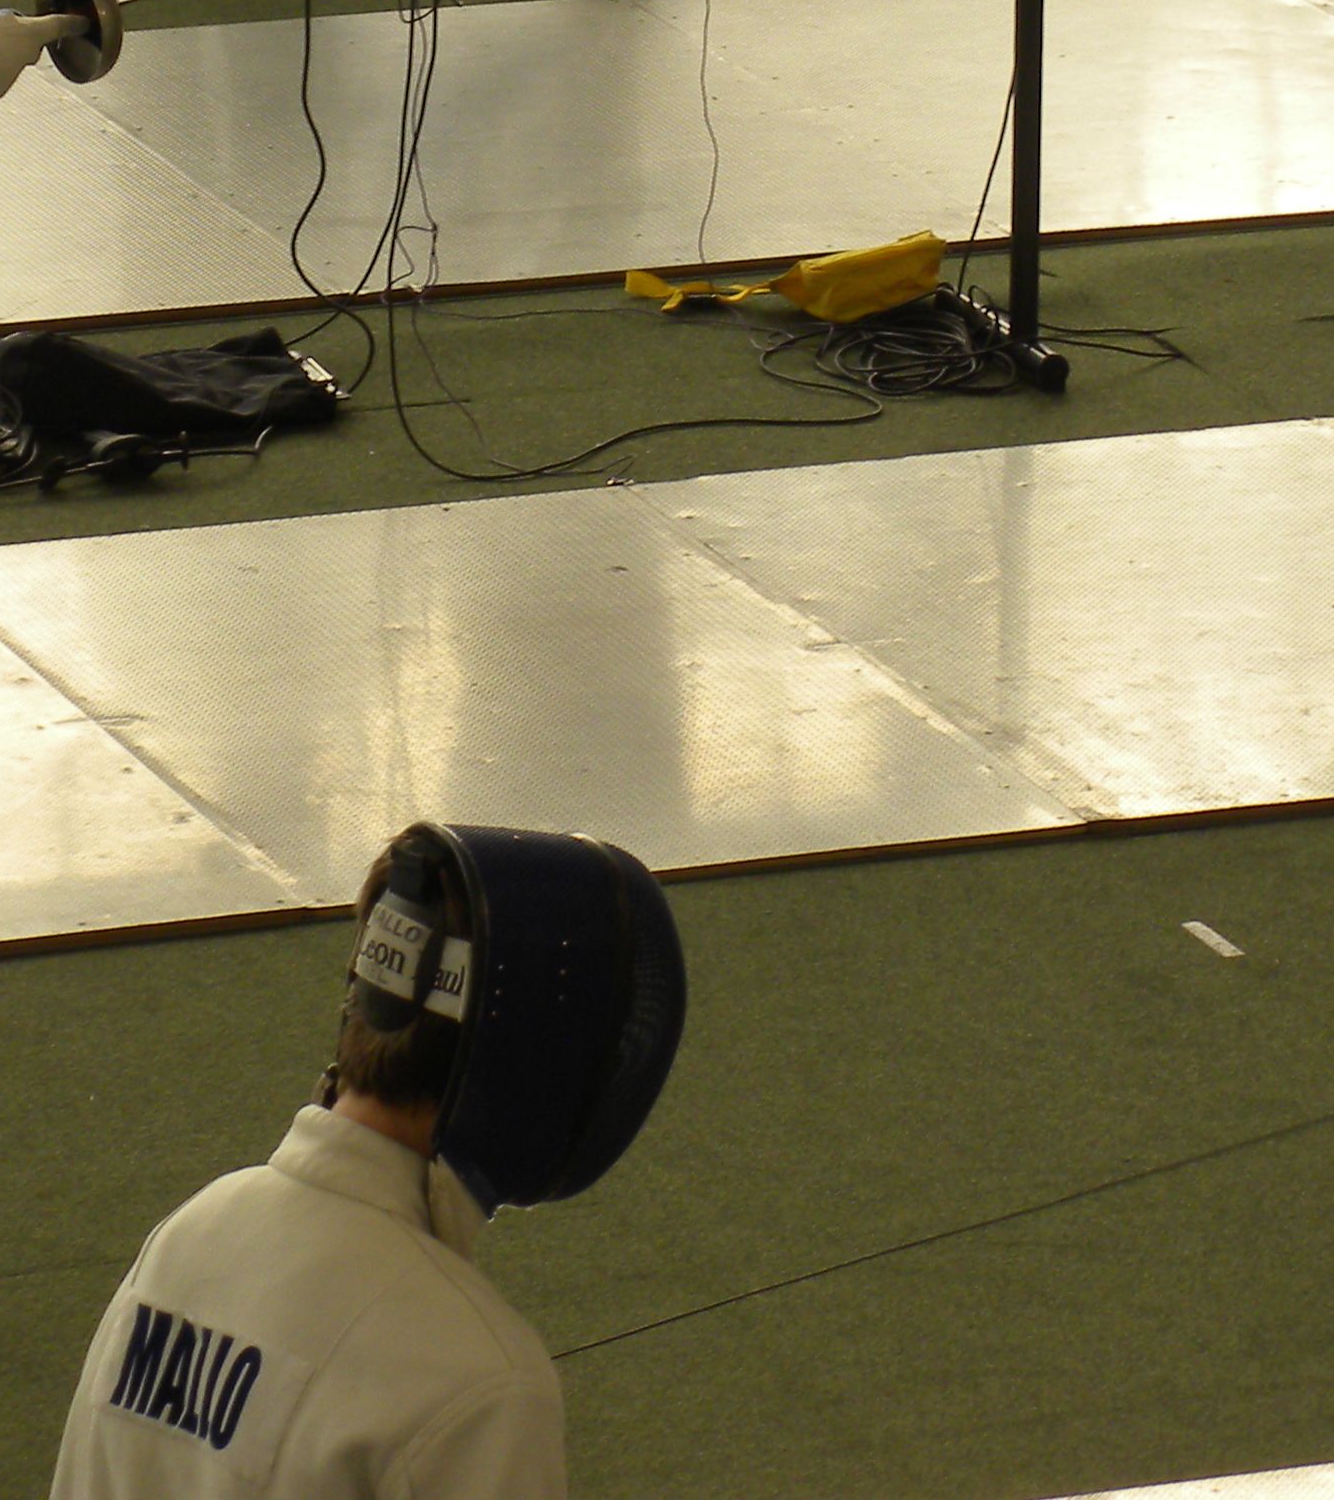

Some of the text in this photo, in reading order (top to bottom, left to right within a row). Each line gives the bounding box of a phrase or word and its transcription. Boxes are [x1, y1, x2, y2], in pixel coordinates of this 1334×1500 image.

[370, 907, 424, 944] ALLO
[360, 938, 407, 975] eon
[109, 1303, 263, 1451] MALLO
